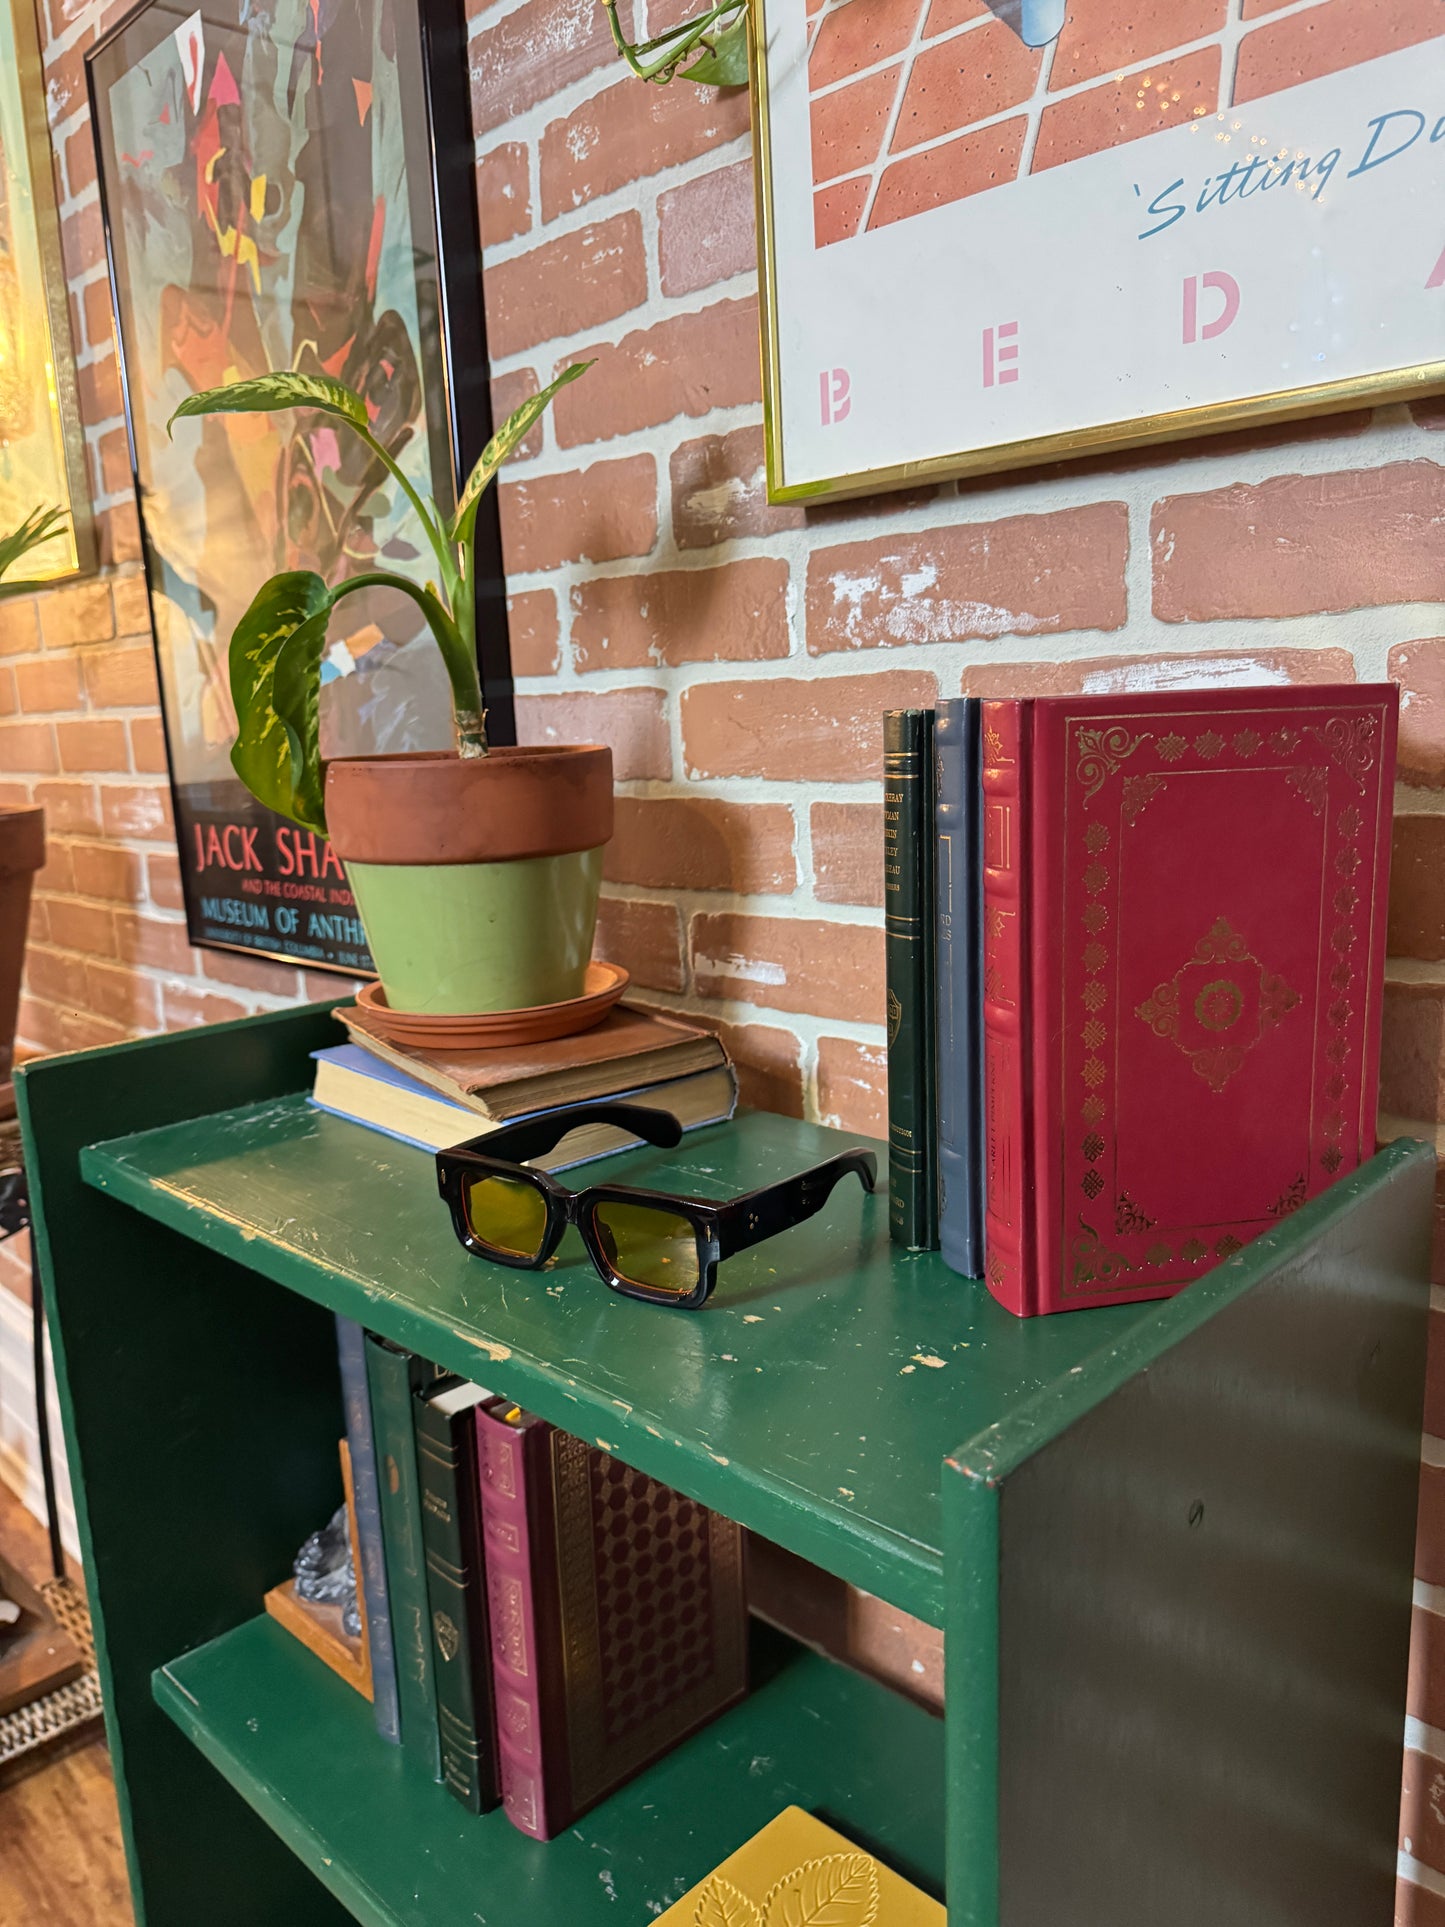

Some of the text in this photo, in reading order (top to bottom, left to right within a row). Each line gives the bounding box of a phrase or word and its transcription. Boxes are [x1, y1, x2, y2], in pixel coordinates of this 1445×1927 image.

[193, 823, 263, 873] JACK
[263, 880, 281, 897] THE
[283, 882, 327, 903] COASTAL
[201, 897, 270, 930] MUSEUM
[274, 906, 299, 934] OF
